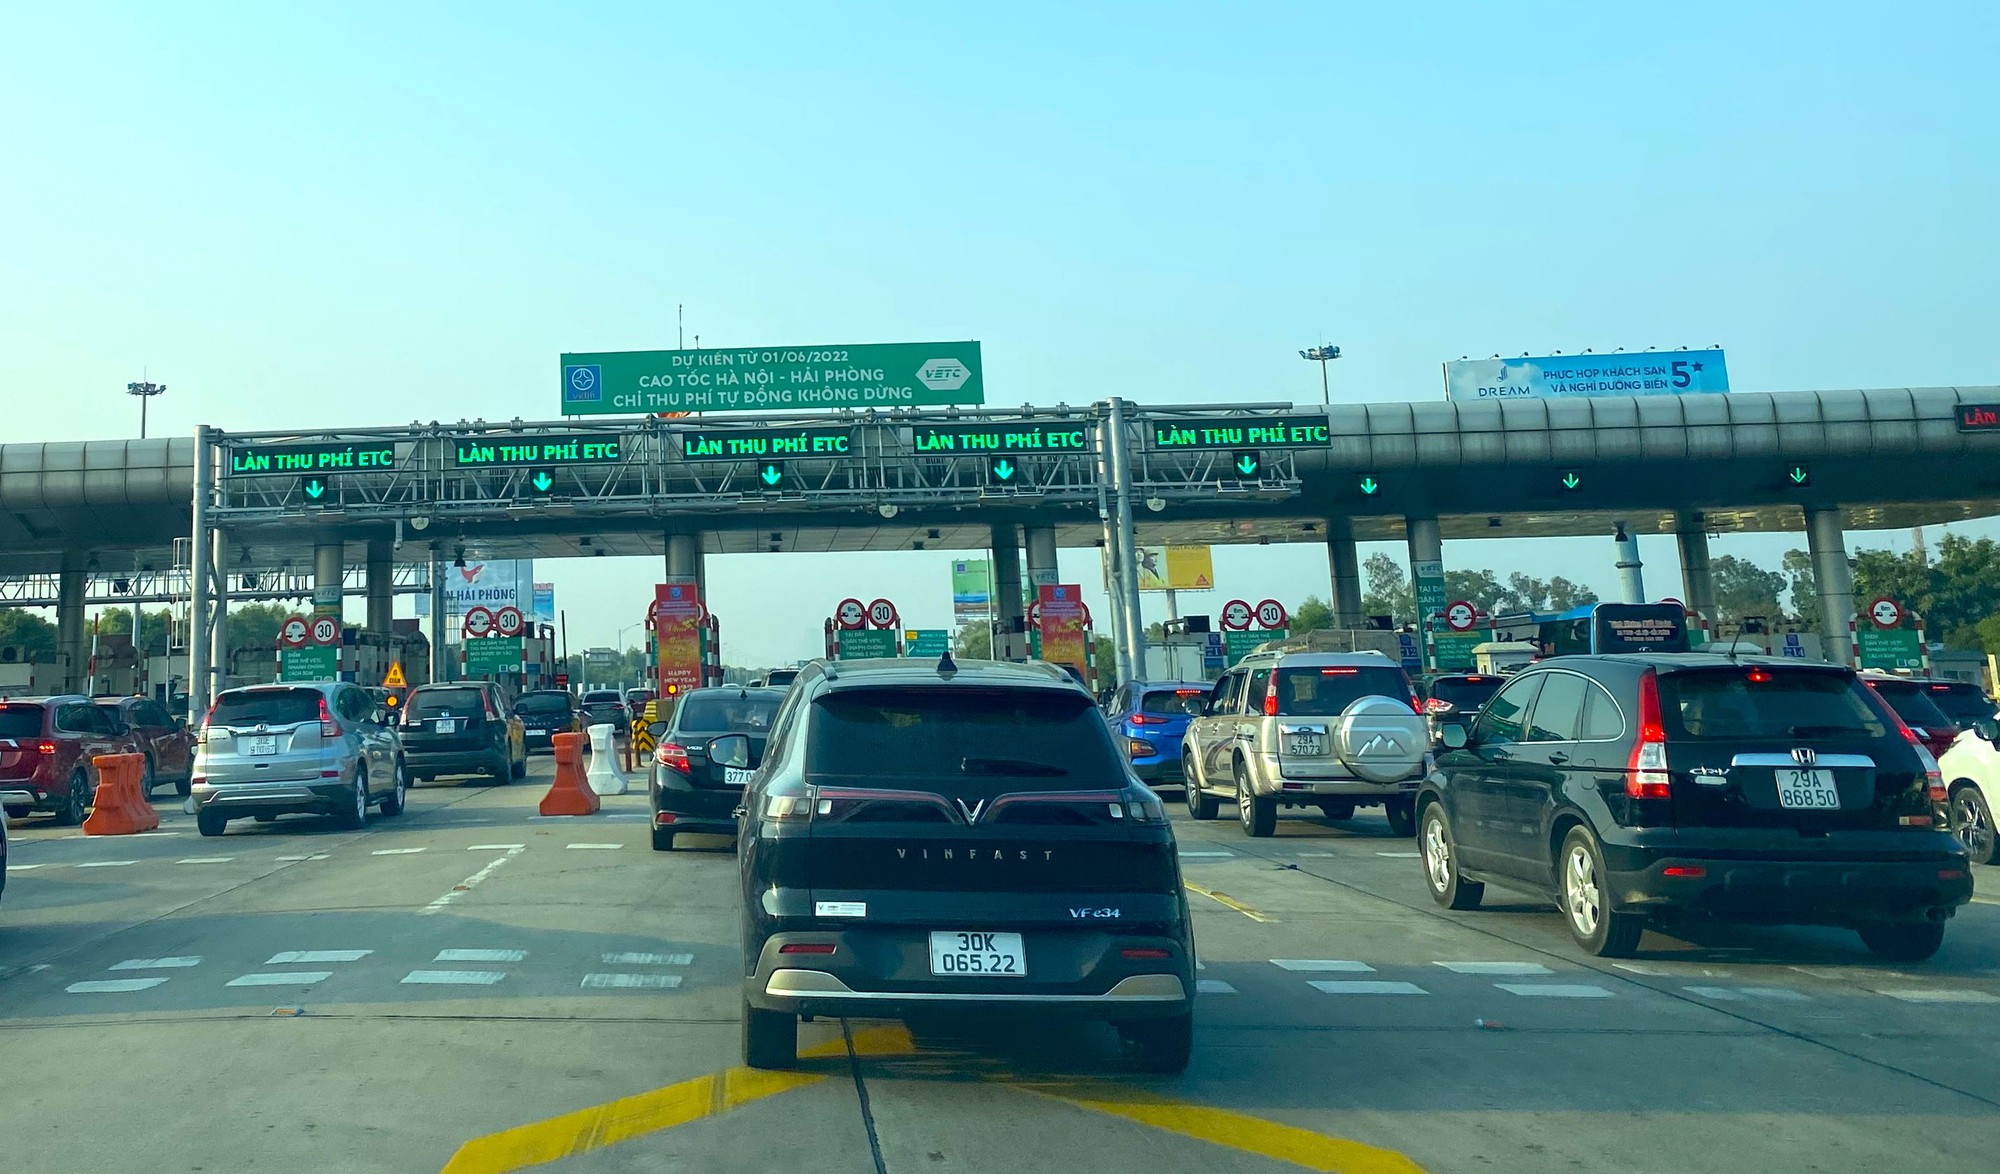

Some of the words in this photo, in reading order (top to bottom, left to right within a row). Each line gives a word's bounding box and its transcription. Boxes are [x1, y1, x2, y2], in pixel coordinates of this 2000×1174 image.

[699, 350, 733, 366] KIẾN
[738, 350, 758, 364] TỪ
[761, 350, 849, 364] 01/06/2022
[639, 374, 673, 388] CAO
[678, 369, 711, 387] TỐC
[716, 369, 739, 386] HÀ
[744, 368, 774, 387] NỘI
[791, 366, 818, 383] HẢI
[824, 365, 884, 382] PHÒNG
[925, 368, 962, 379] VETC
[1671, 361, 1691, 388] 5
[613, 390, 642, 408] CHỈ
[647, 393, 680, 406] THU
[685, 388, 713, 405] PHÍ
[717, 391, 740, 407] TỰ
[743, 386, 792, 406] ĐỘNG
[798, 385, 858, 402] KHÔNG
[864, 384, 913, 400] DỪNG
[1478, 385, 1531, 397] DREAM
[1964, 407, 1997, 425] LÀN
[916, 430, 954, 450] LÀN
[958, 433, 999, 449] THU
[1005, 428, 1042, 448] PHÍ
[1047, 431, 1084, 447] ETC
[1157, 424, 1196, 445] LÀN
[1200, 428, 1242, 444] THU
[1248, 422, 1286, 443] PHÍ
[1290, 426, 1327, 442] ETC
[458, 442, 494, 463] LÀN
[500, 445, 538, 461] THU
[544, 439, 578, 460] PHÍ
[584, 443, 618, 458] ETC
[686, 435, 722, 455] LÀN
[727, 438, 766, 454] THU
[772, 432, 808, 452] PHÍ
[813, 436, 848, 452] ETC
[234, 451, 269, 471] LÀN
[274, 454, 313, 469] THU
[318, 447, 353, 467] PHÍ
[359, 450, 392, 466] ETC
[457, 587, 475, 601] HẢI
[478, 586, 516, 600] PHÒNG
[502, 614, 516, 628] 30
[875, 606, 889, 620] 30
[1262, 607, 1278, 621] 30
[317, 624, 331, 638] 30
[1297, 735, 1313, 745] 29A
[1792, 771, 1822, 788] 29A
[1783, 789, 1837, 807] 868.50
[897, 848, 1052, 861] VINFAST
[957, 933, 997, 952] 30K
[942, 953, 1016, 973] 065.22
